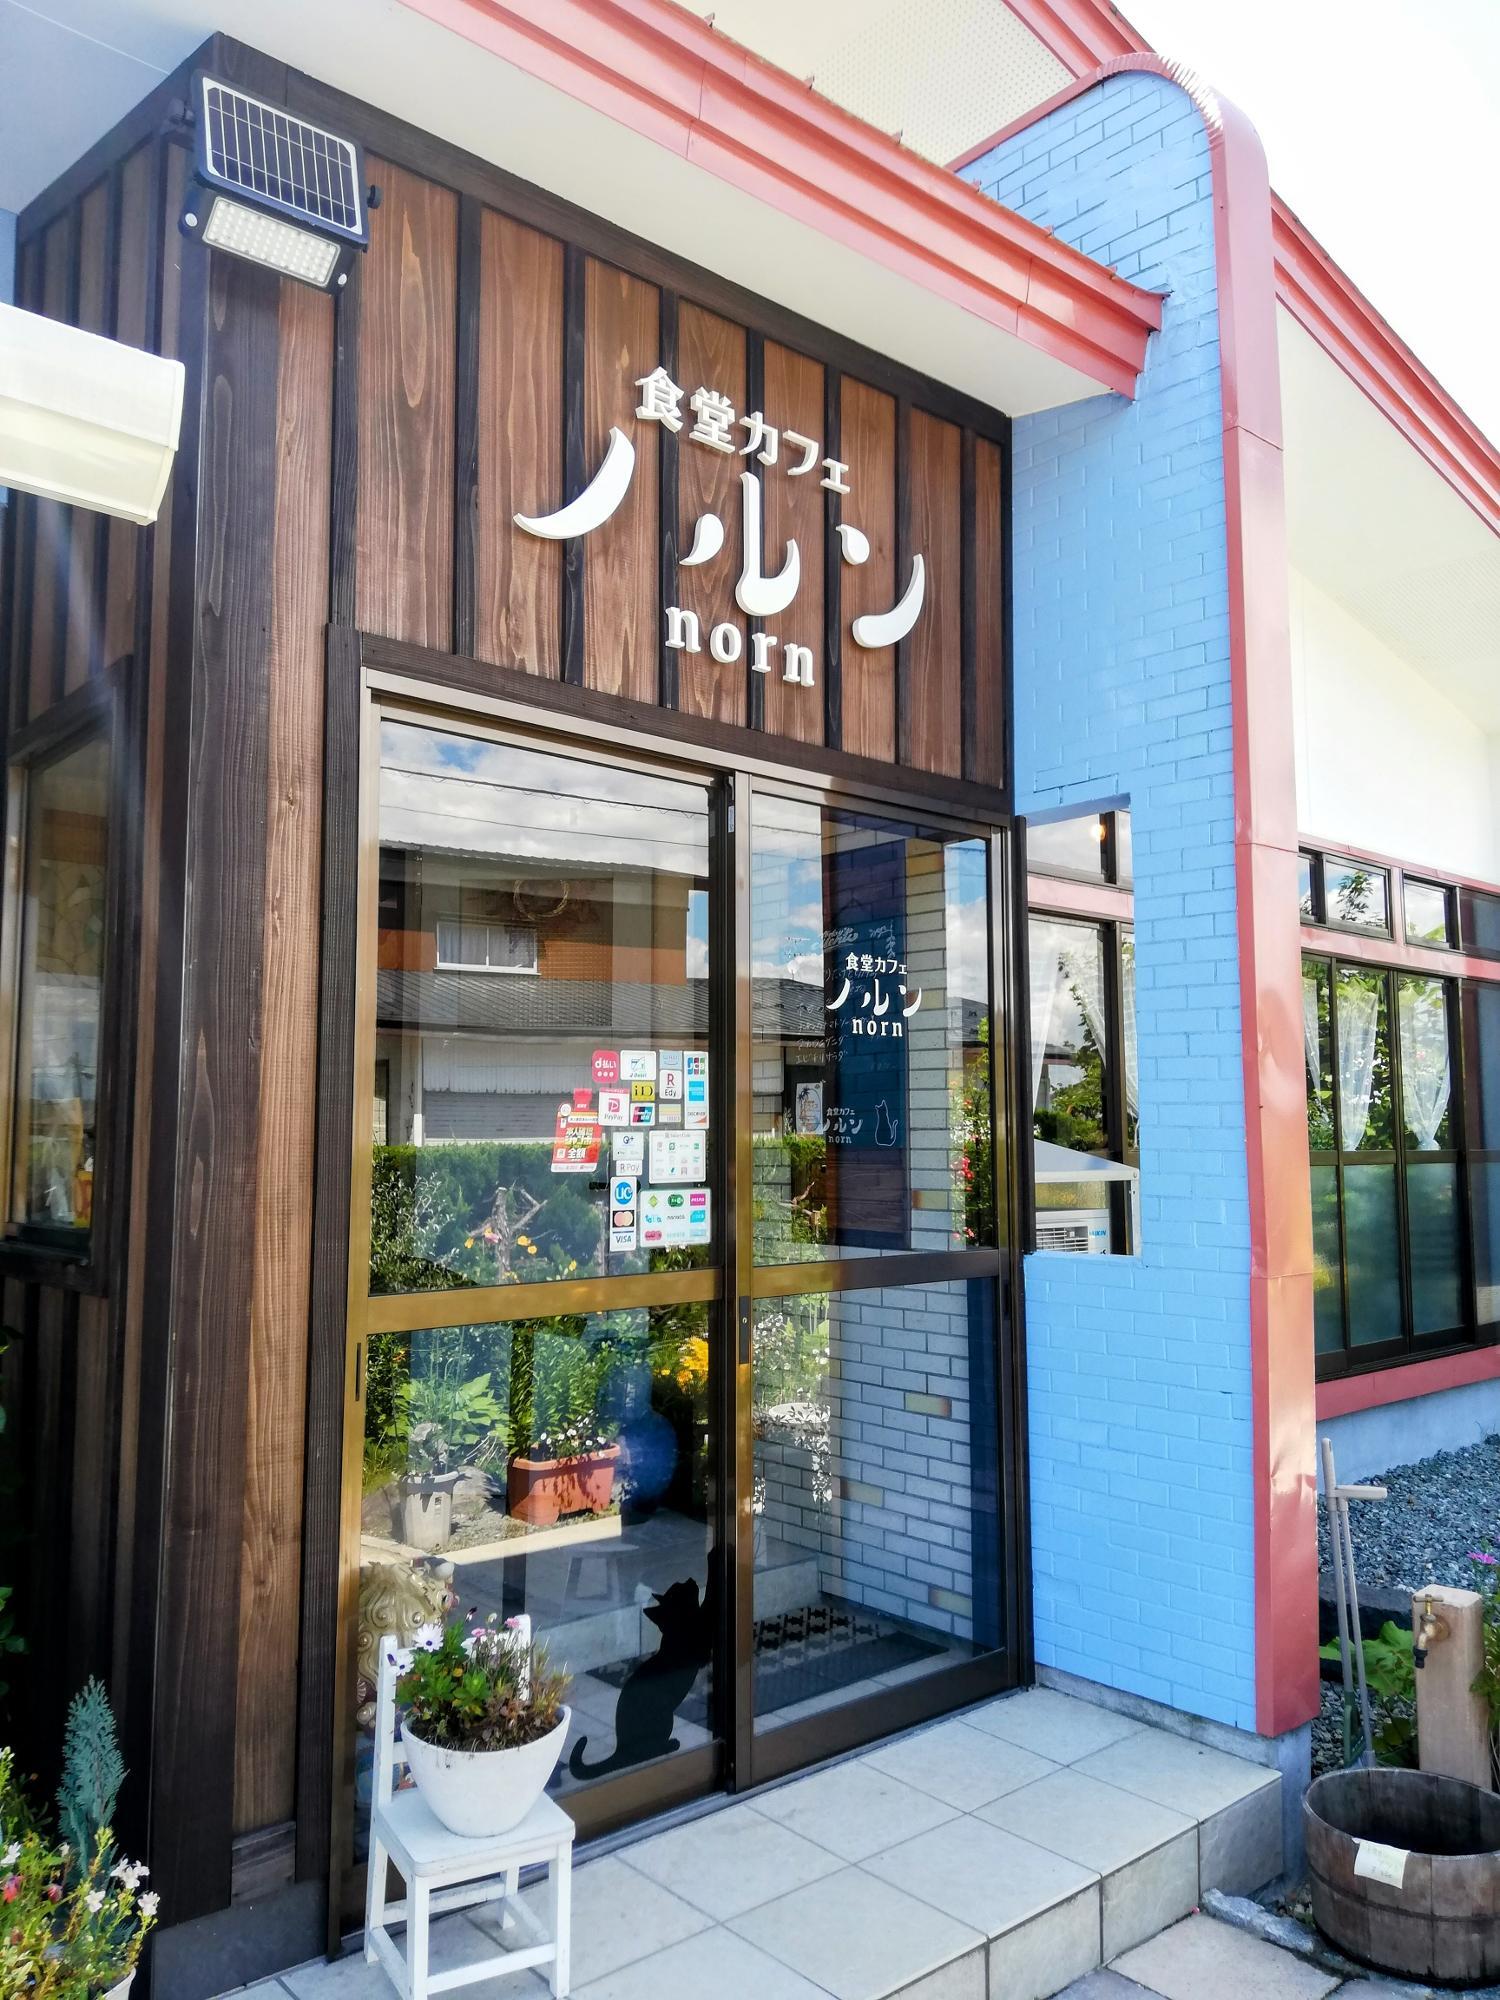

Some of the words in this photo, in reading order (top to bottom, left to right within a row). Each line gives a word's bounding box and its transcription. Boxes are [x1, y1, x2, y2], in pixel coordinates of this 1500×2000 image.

[635, 366, 850, 495] 食堂カフェ
[513, 426, 926, 648] ノルン
[665, 605, 815, 687] norn
[845, 952, 908, 975] 食堂カフェ
[826, 978, 922, 1017] ノルン
[852, 1018, 903, 1037] norn
[595, 1057, 616, 1068] d払い
[635, 1085, 653, 1096] iD
[665, 1088, 677, 1098] Edy
[604, 1112, 624, 1122] PayPay
[826, 1107, 856, 1116] 食堂カフェ
[828, 1135, 852, 1144] norn
[616, 1186, 633, 1200] UC
[615, 1234, 632, 1244] VISA
